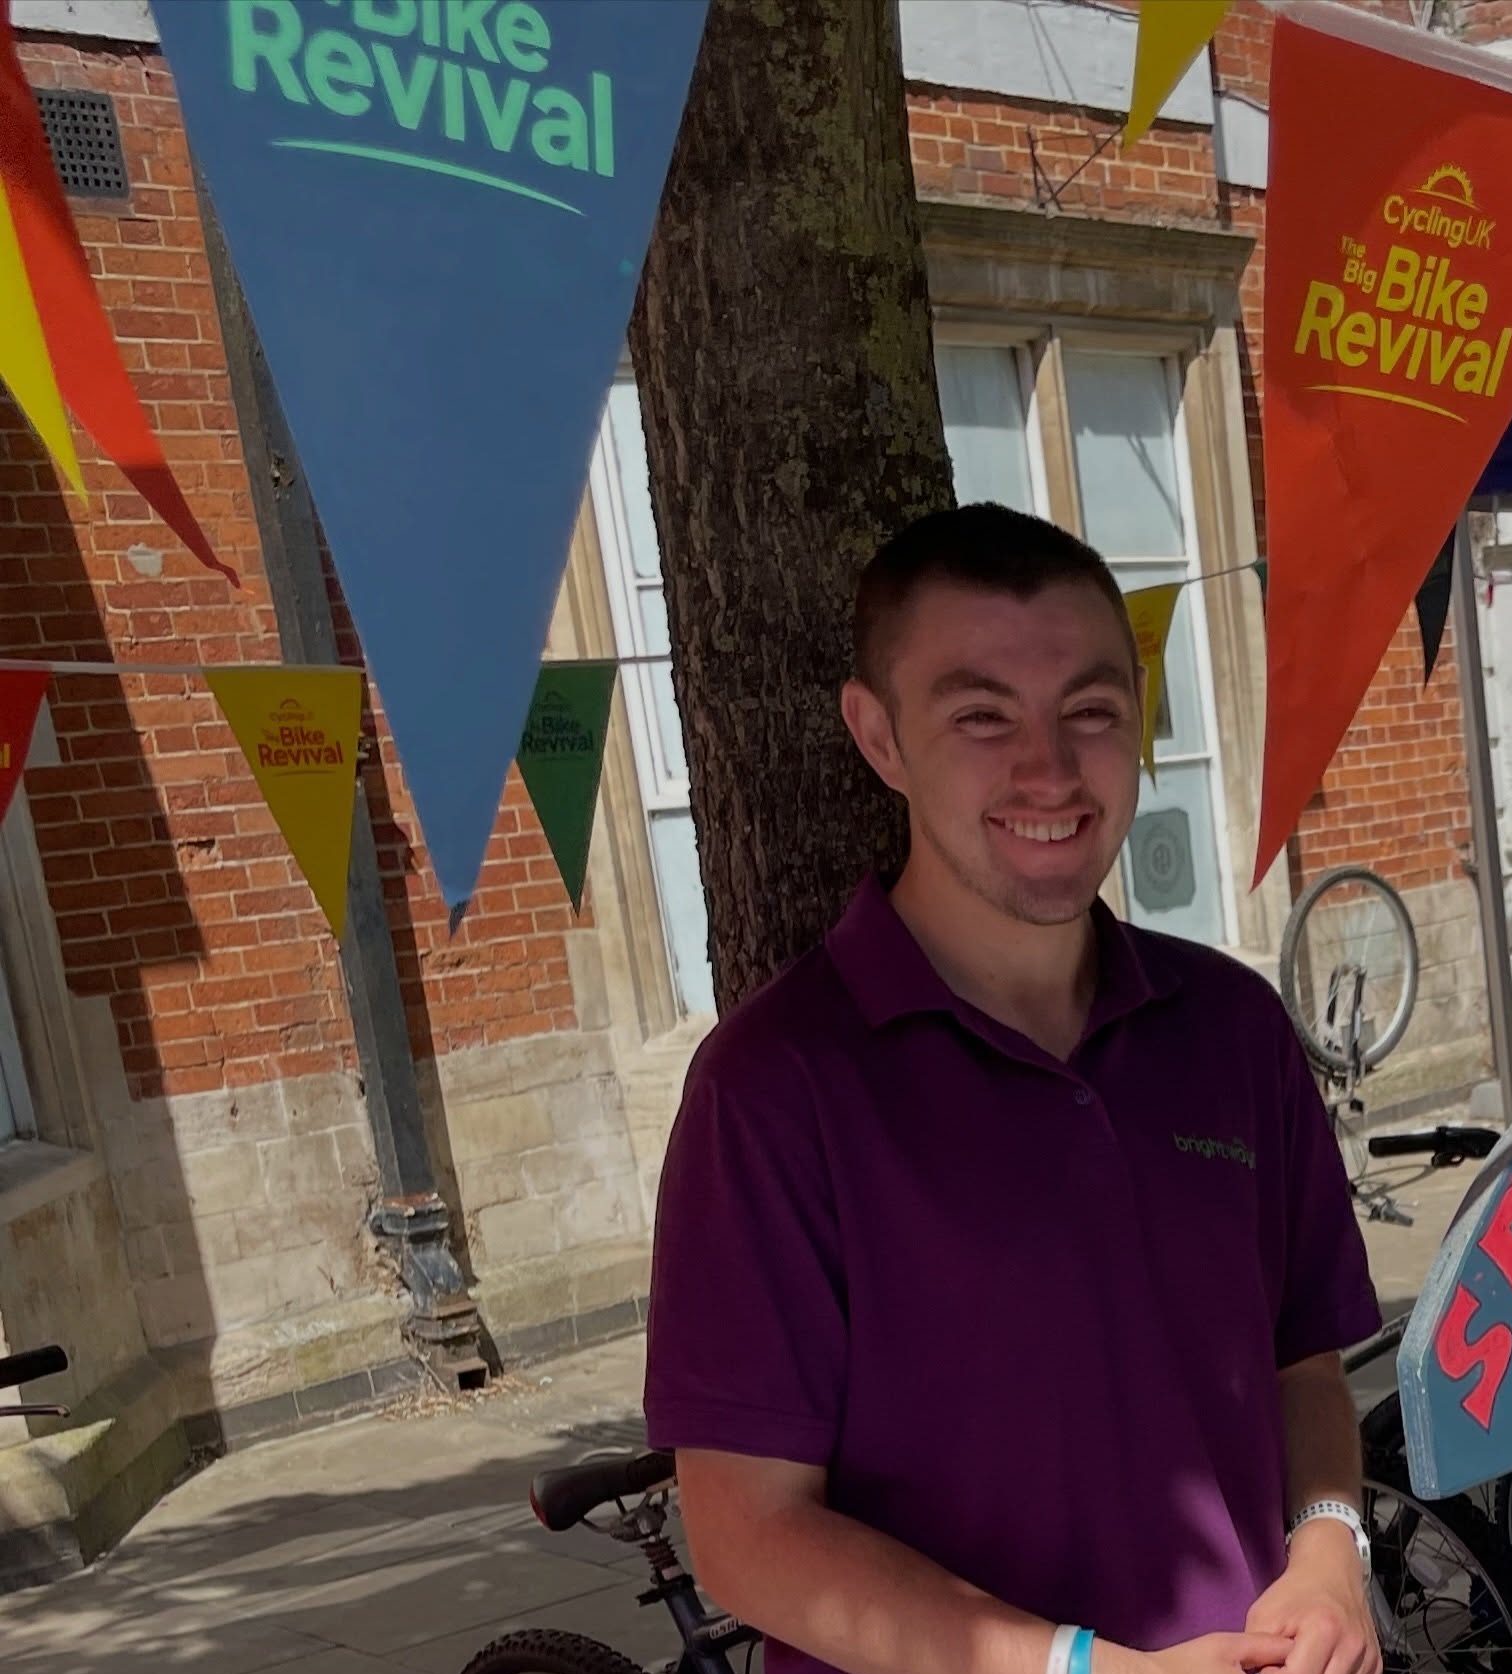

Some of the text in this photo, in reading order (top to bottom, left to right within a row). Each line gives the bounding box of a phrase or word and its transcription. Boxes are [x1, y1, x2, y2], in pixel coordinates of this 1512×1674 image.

[228, 0, 615, 178] Revival
[1341, 235, 1366, 258] The
[1343, 245, 1488, 331] Big Bike
[279, 726, 326, 745] Bike
[541, 716, 582, 735] Bike
[521, 730, 595, 753] Revival
[256, 741, 345, 769] Revival
